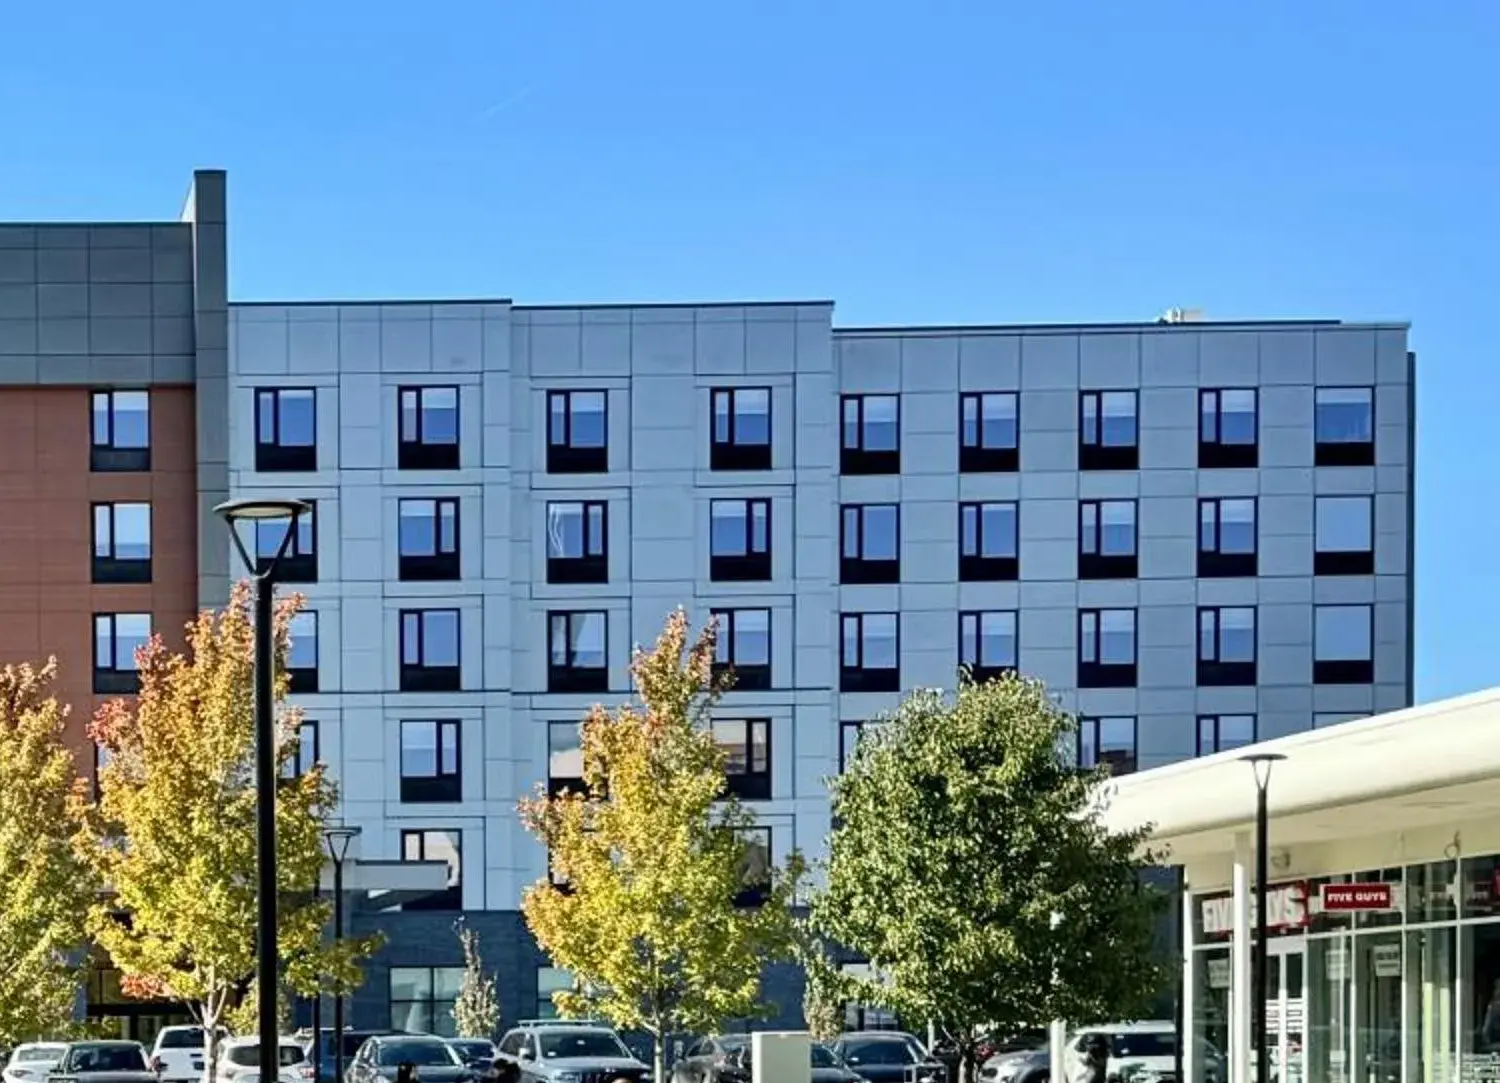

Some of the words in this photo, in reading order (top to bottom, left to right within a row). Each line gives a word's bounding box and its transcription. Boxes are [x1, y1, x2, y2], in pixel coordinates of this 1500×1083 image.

[1327, 892, 1353, 903] FIVE
[1355, 891, 1387, 902] GUYS
[1202, 897, 1236, 933] FIV
